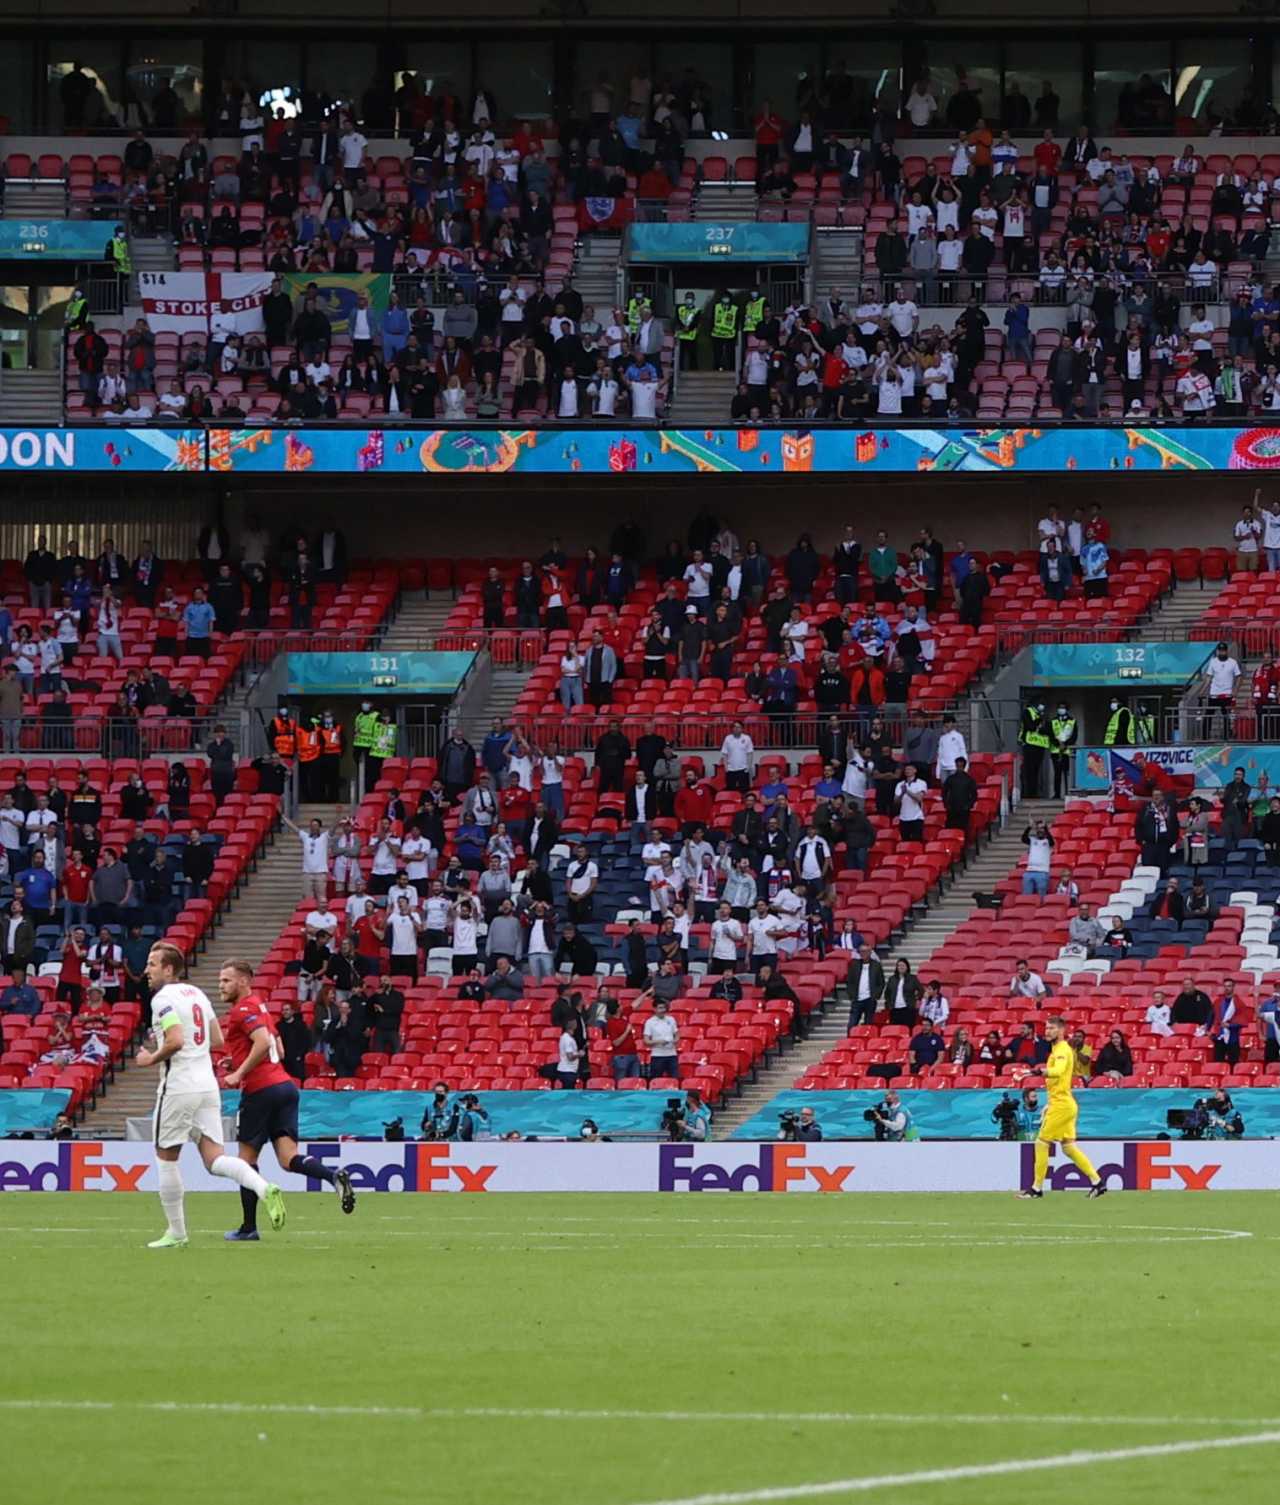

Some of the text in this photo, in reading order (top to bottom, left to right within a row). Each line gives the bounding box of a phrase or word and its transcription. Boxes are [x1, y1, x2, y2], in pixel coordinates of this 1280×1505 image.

[20, 225, 48, 238] 236
[706, 227, 734, 240] 237
[155, 301, 220, 314] STOKE
[0, 431, 75, 466] ON
[370, 656, 399, 671] 131
[1115, 647, 1145, 662] 132
[192, 1003, 206, 1046] 9
[307, 1144, 498, 1192] FedEx
[659, 1144, 855, 1192] FedEx
[1020, 1142, 1222, 1191] FedEx
